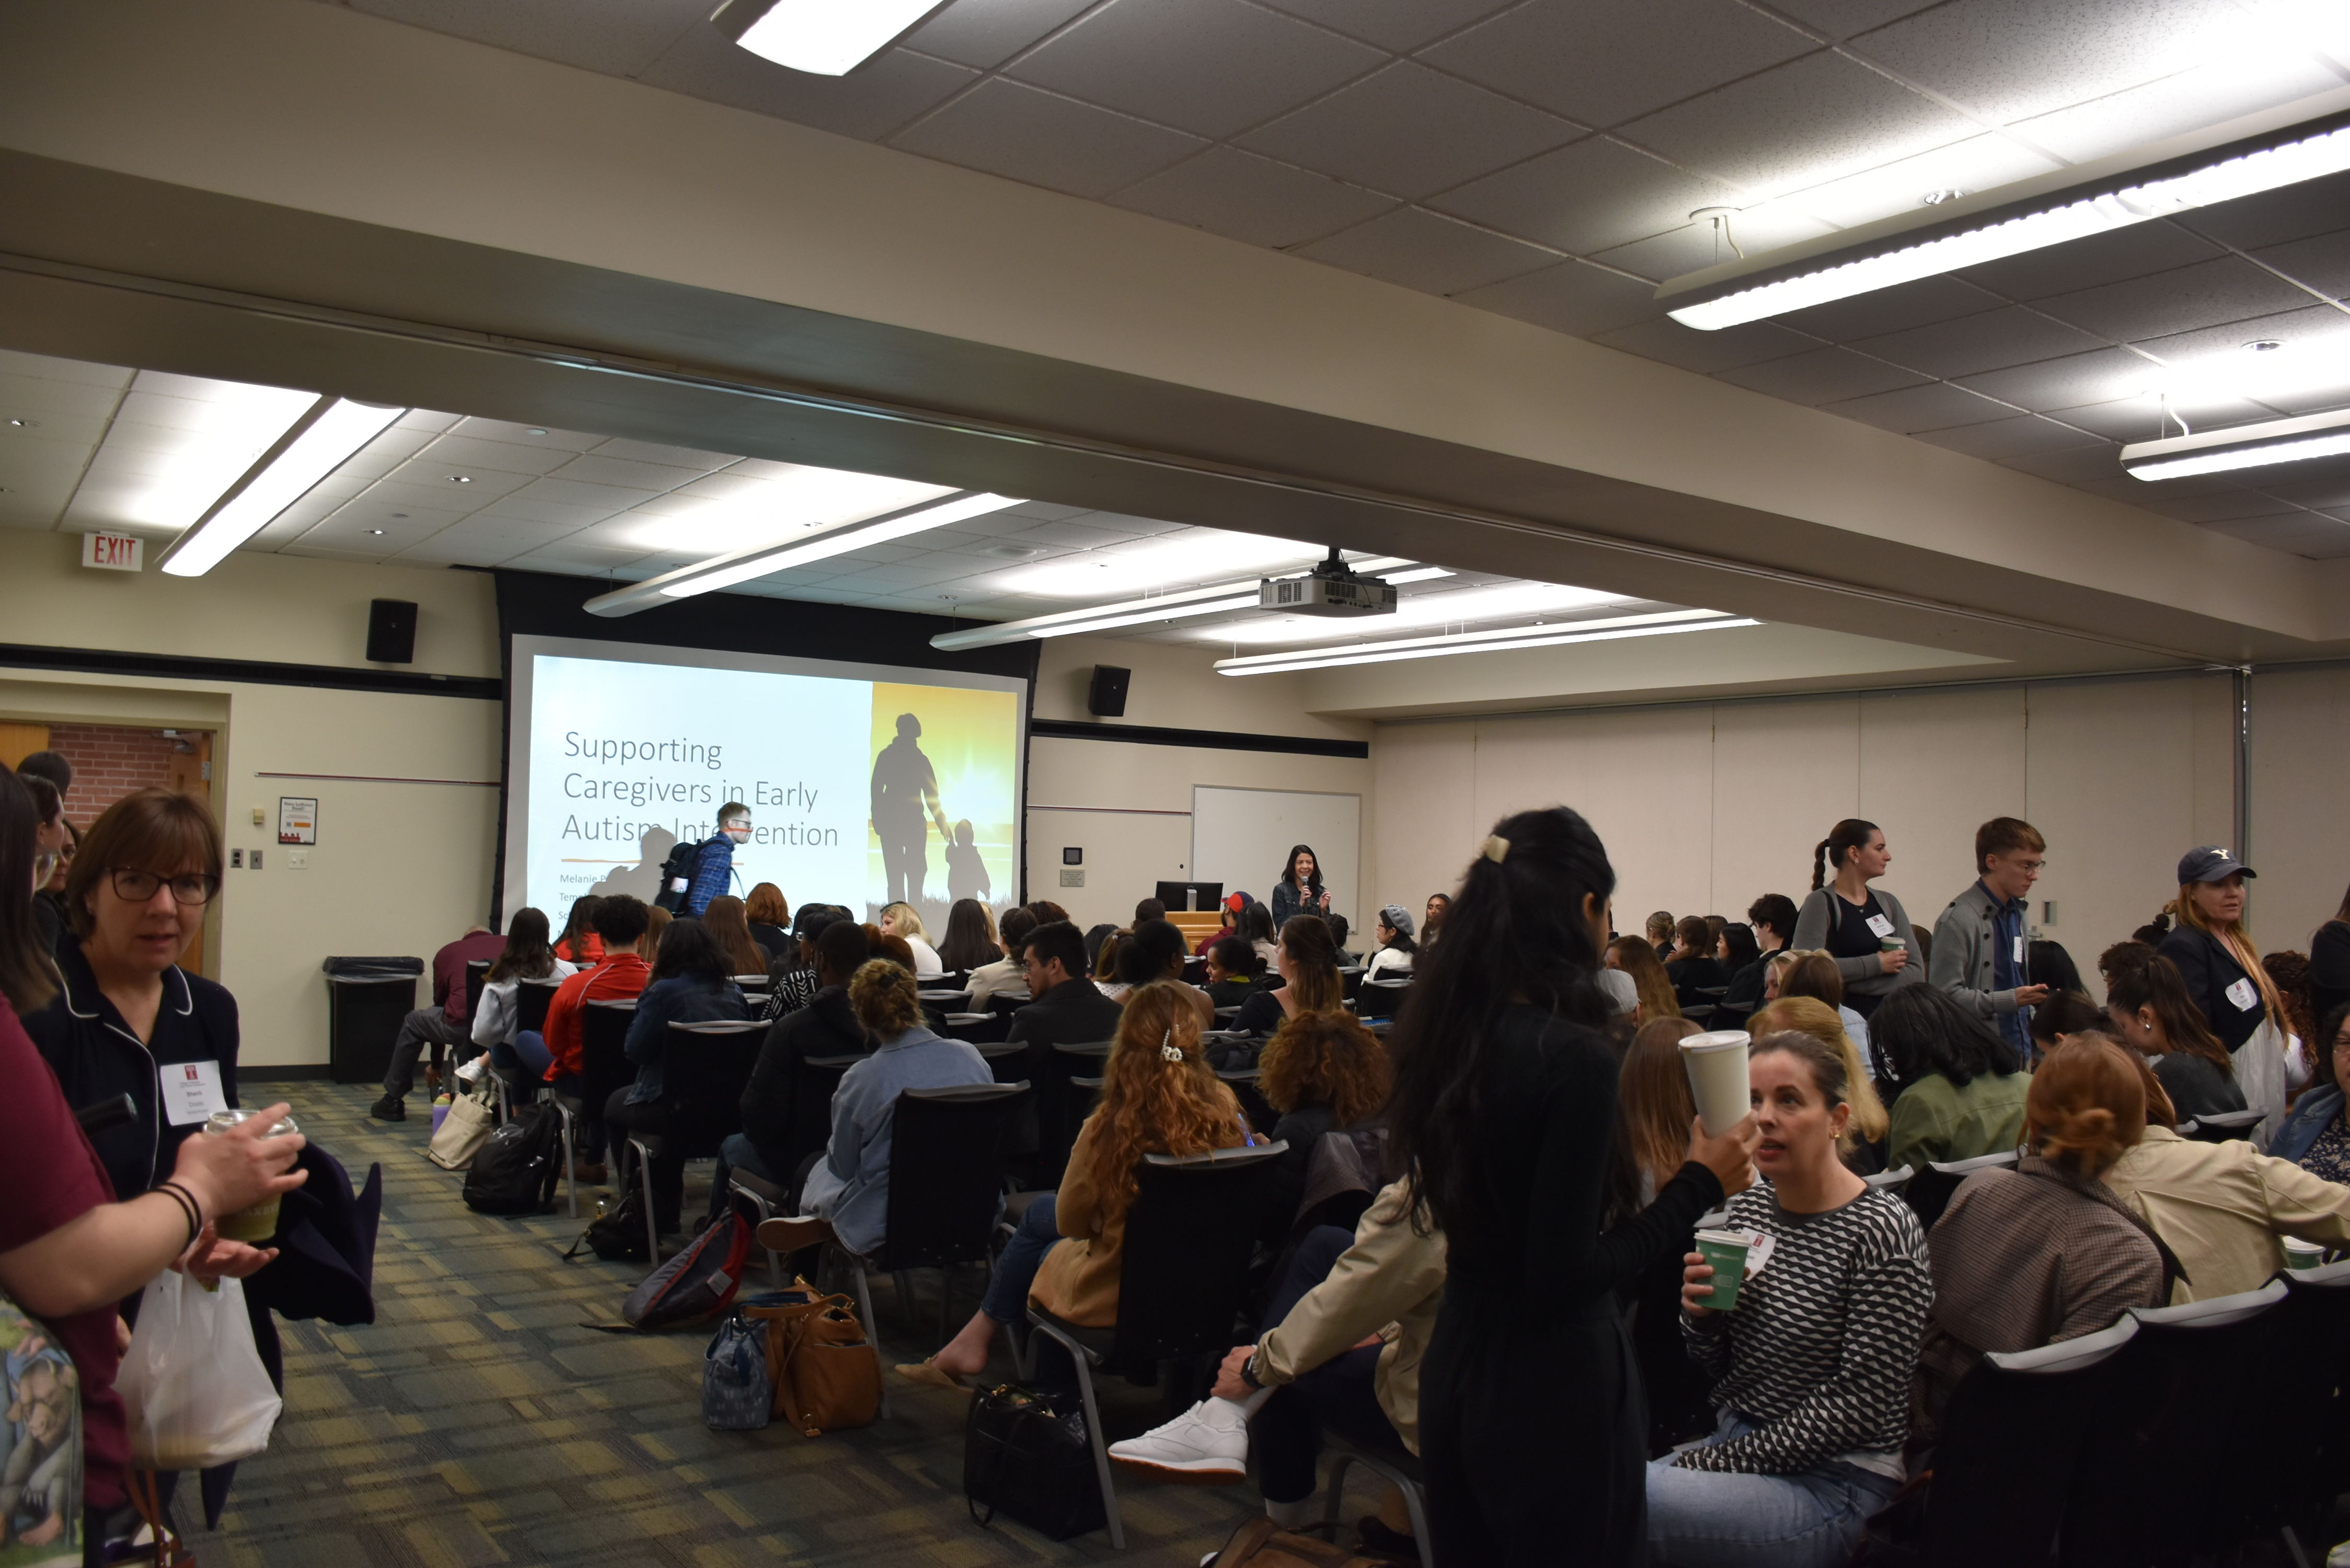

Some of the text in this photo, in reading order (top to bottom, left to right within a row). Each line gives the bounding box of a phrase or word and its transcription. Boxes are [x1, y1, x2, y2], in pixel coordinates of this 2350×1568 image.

[94, 536, 136, 566] EXIT
[565, 731, 722, 770] Supporting
[564, 773, 818, 813] Caregivers in Early
[2210, 849, 2229, 860] Y
[560, 874, 597, 883] Melanie
